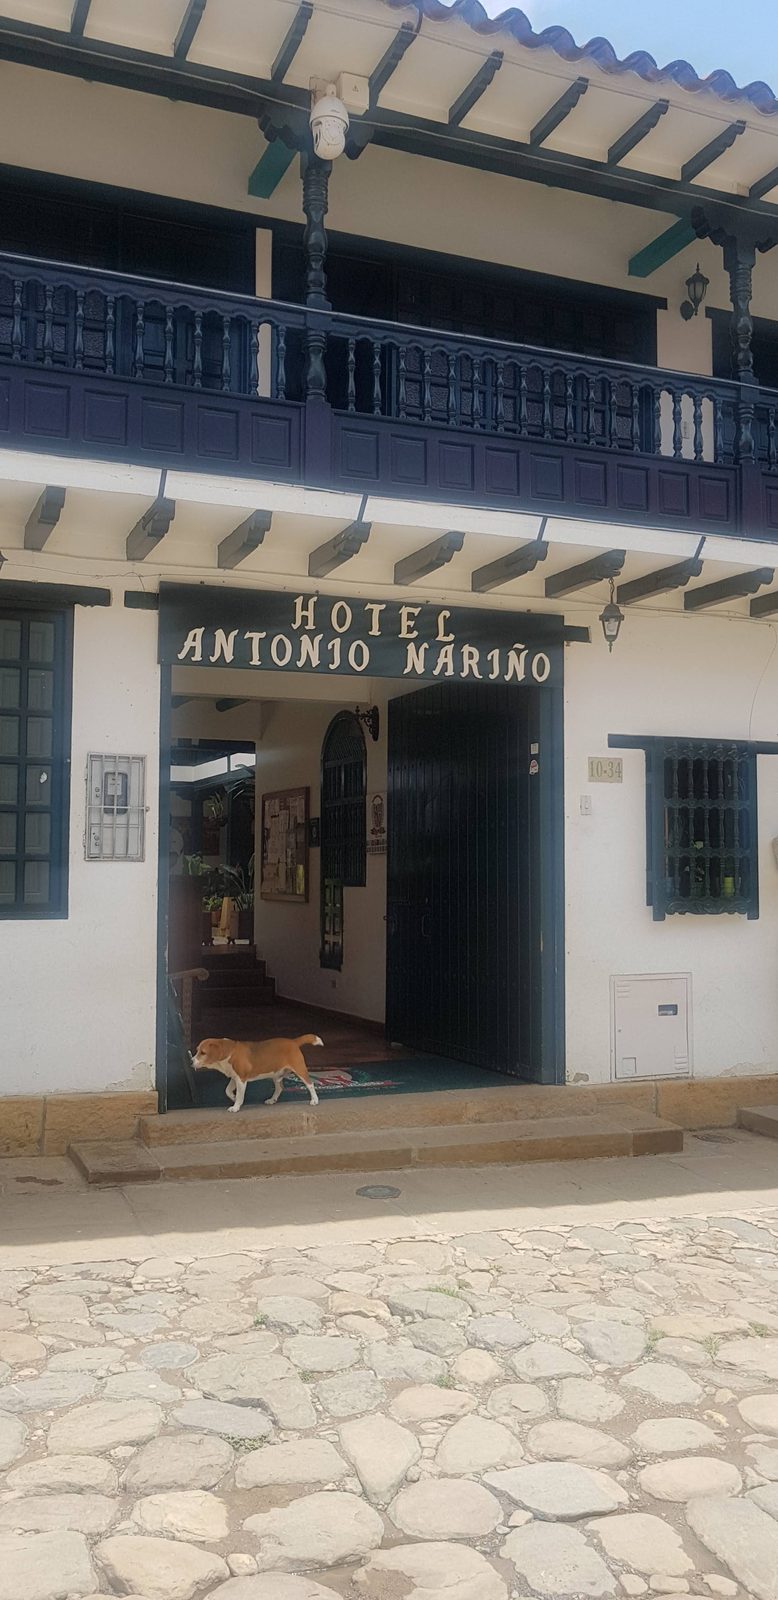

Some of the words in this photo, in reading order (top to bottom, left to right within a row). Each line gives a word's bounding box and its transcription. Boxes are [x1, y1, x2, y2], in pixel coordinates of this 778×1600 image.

[291, 595, 455, 642] HOTEL
[177, 626, 370, 672] ANTONIO
[403, 641, 551, 682] NARIÑO
[589, 760, 622, 779] 10-34
